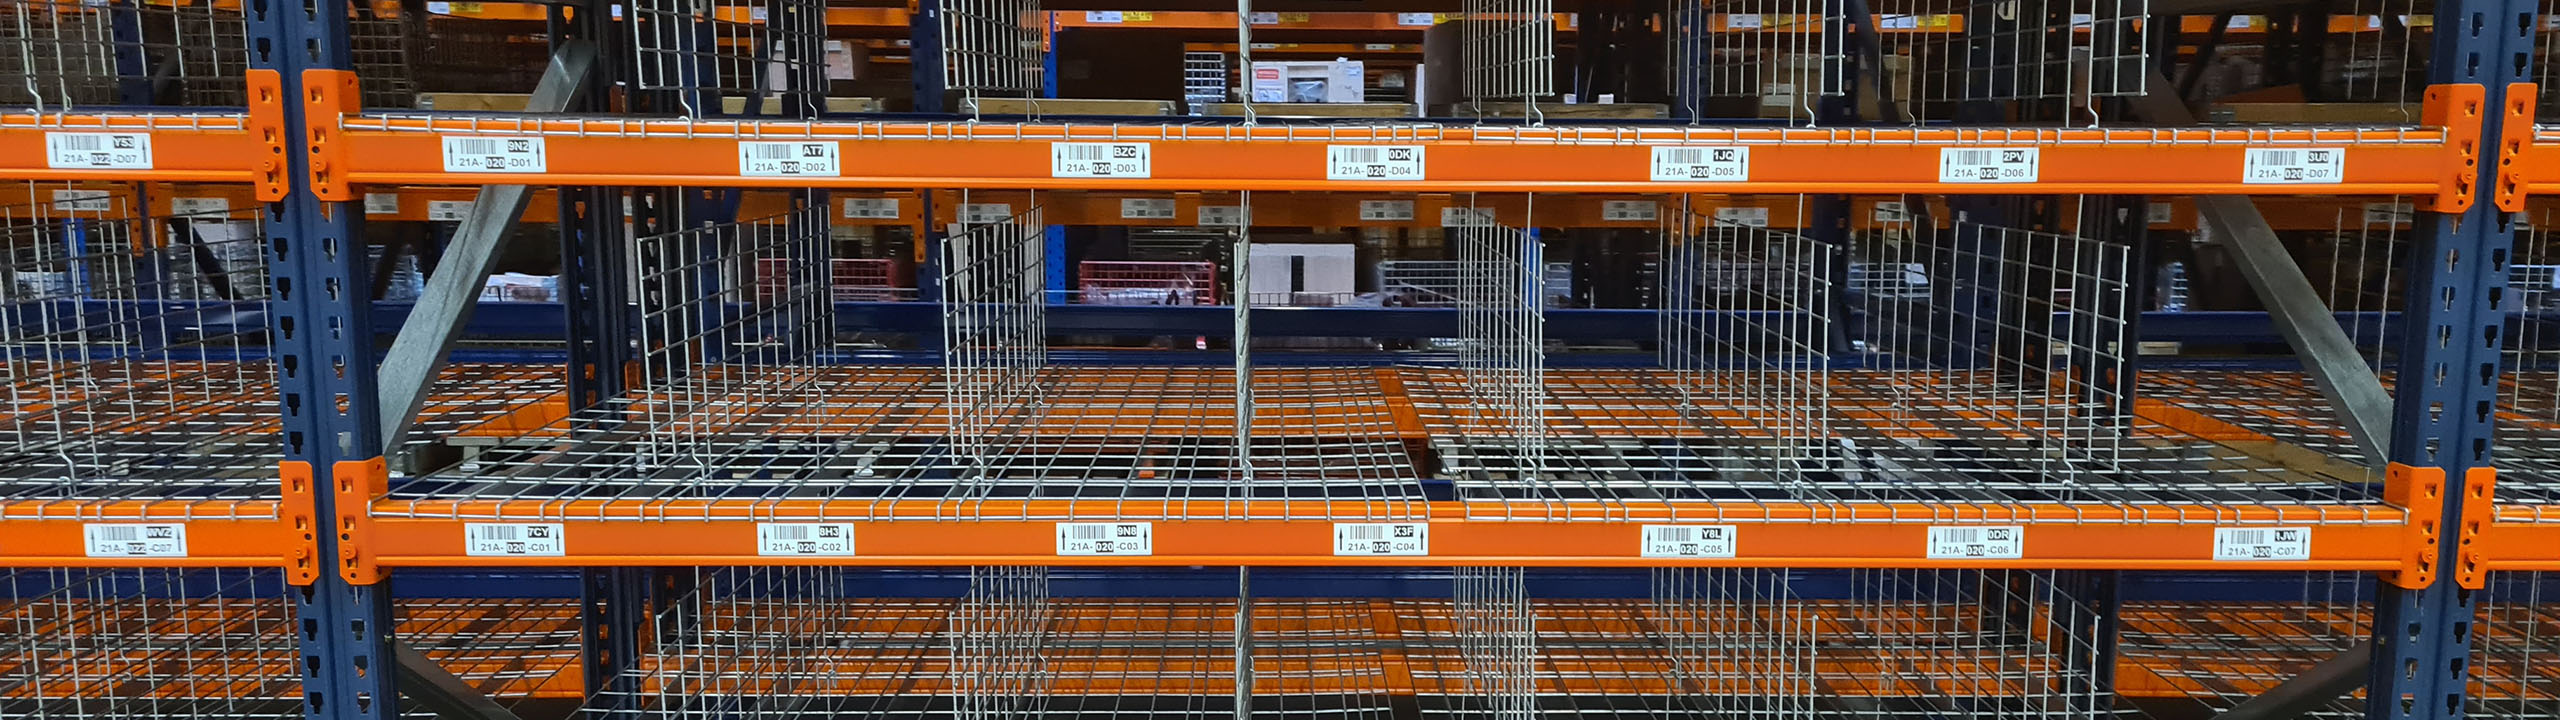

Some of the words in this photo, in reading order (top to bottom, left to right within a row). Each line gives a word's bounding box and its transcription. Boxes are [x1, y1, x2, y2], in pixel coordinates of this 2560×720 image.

[508, 141, 529, 151] 9N2
[803, 146, 823, 156] AT7
[1114, 147, 1136, 157] BZC
[1389, 150, 1411, 159] 0DK
[1714, 150, 1734, 160] 1JQ
[2003, 152, 2024, 162] 2PV
[2308, 152, 2329, 162] 3U0
[486, 158, 505, 168] 020
[781, 163, 800, 172] 020
[1093, 164, 1111, 173] 020
[1367, 166, 1386, 176] 020
[1691, 168, 1709, 177] 020
[1980, 169, 1998, 178] 020
[2284, 169, 2303, 178] 020
[528, 527, 549, 537] 7CY
[819, 527, 839, 536] 8H3
[1118, 526, 1137, 536] 9N8
[1394, 527, 1414, 536] X3F
[1702, 529, 1721, 538] Y8L
[1988, 530, 2009, 539] 0DR
[507, 544, 525, 553] 020
[798, 543, 816, 552] 020
[1096, 542, 1114, 551] 020
[1373, 543, 1390, 552] 020
[1680, 545, 1698, 554] 020
[1966, 546, 1984, 555] 020
[2253, 547, 2271, 556] 020
